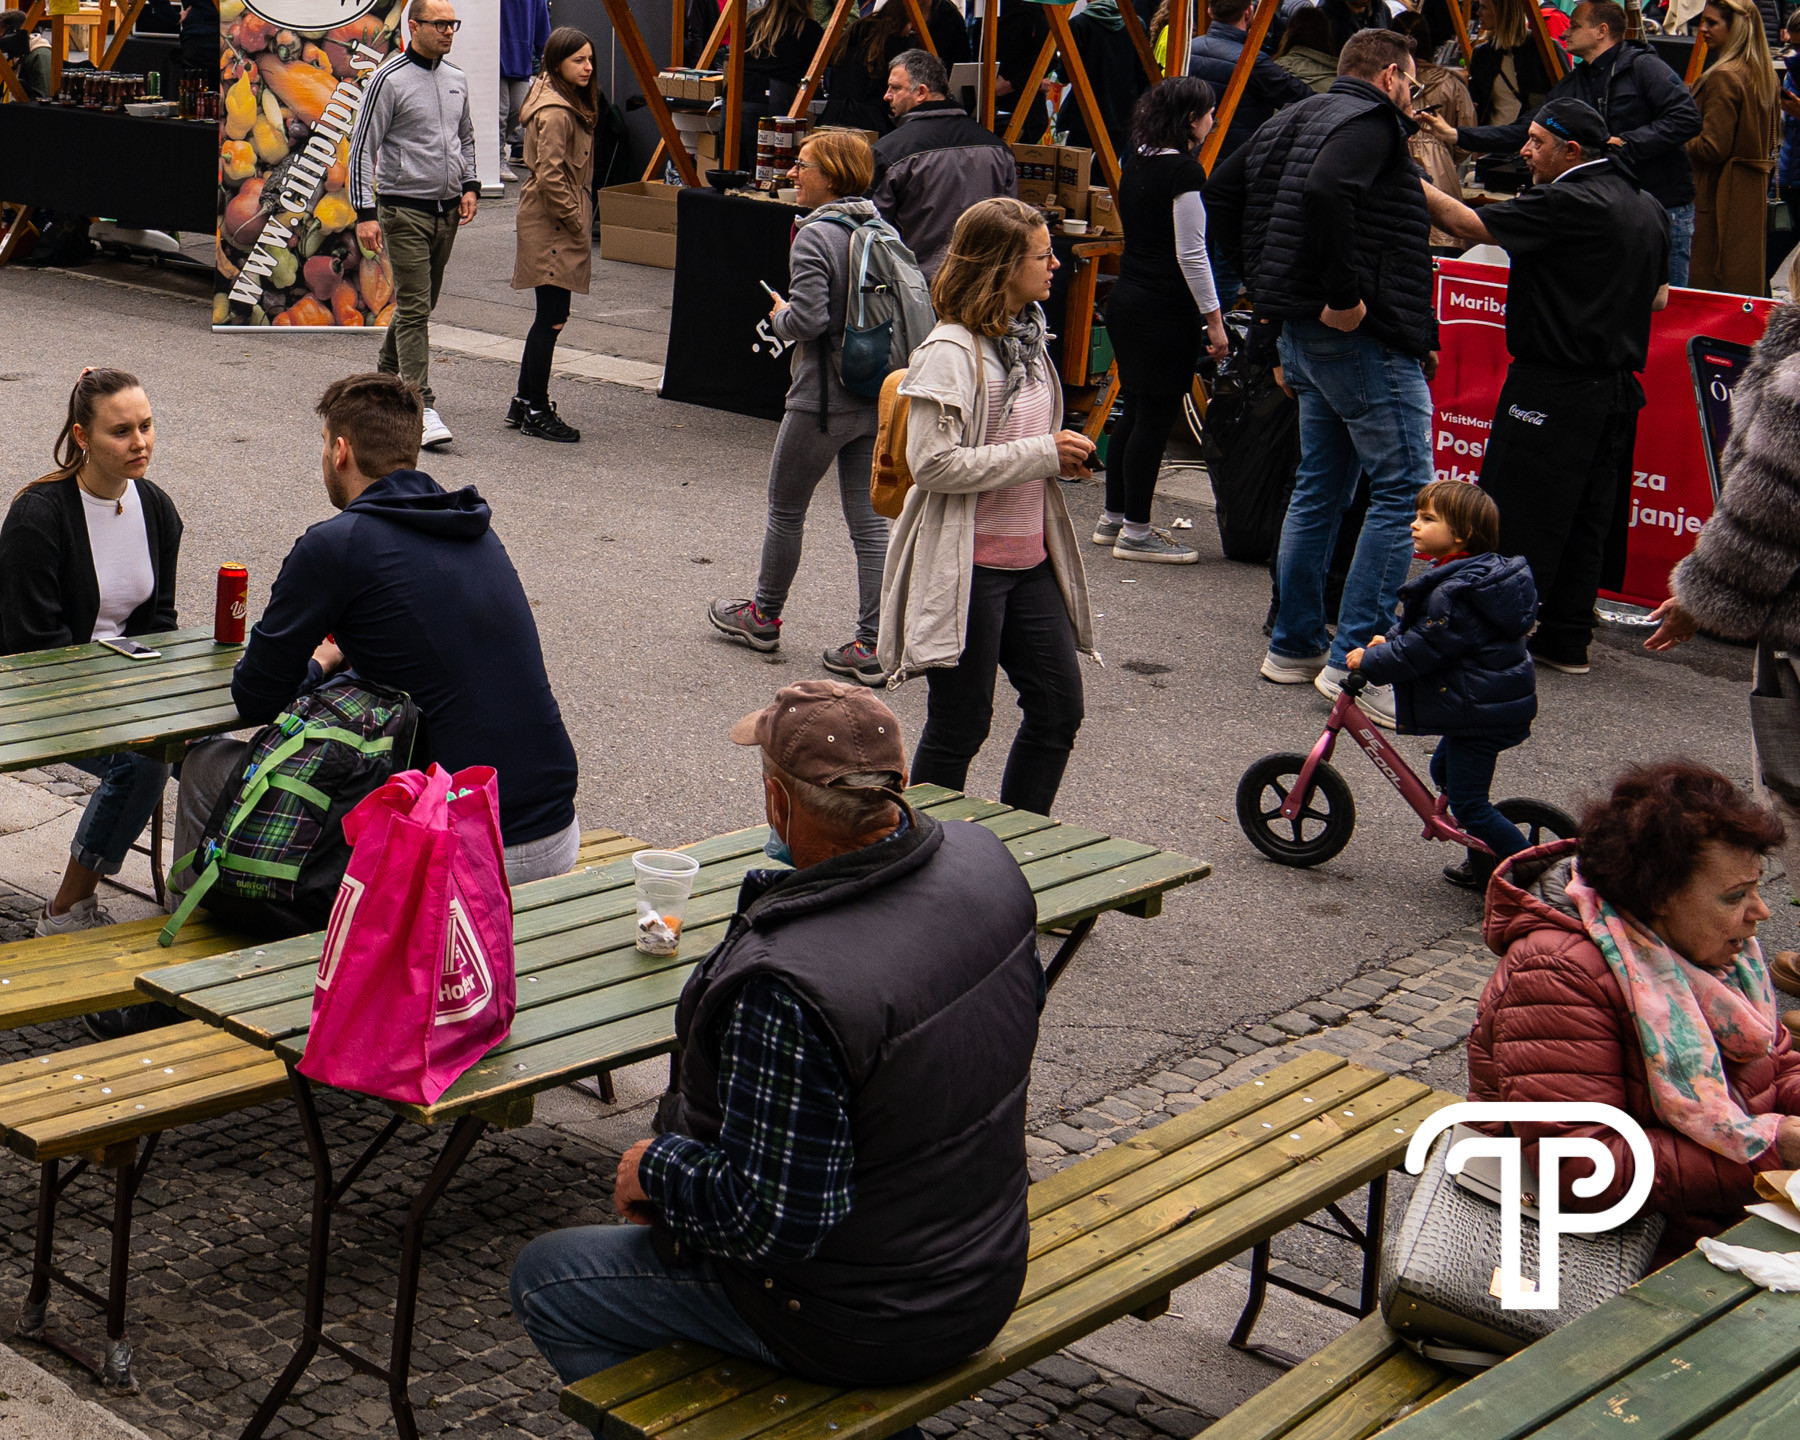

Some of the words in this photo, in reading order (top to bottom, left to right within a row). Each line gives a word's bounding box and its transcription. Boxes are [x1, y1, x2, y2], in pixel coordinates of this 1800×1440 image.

[1632, 470, 1667, 492] za
[1628, 498, 1702, 536] janje
[1359, 728, 1385, 751] BE
[1364, 746, 1401, 789] COOL
